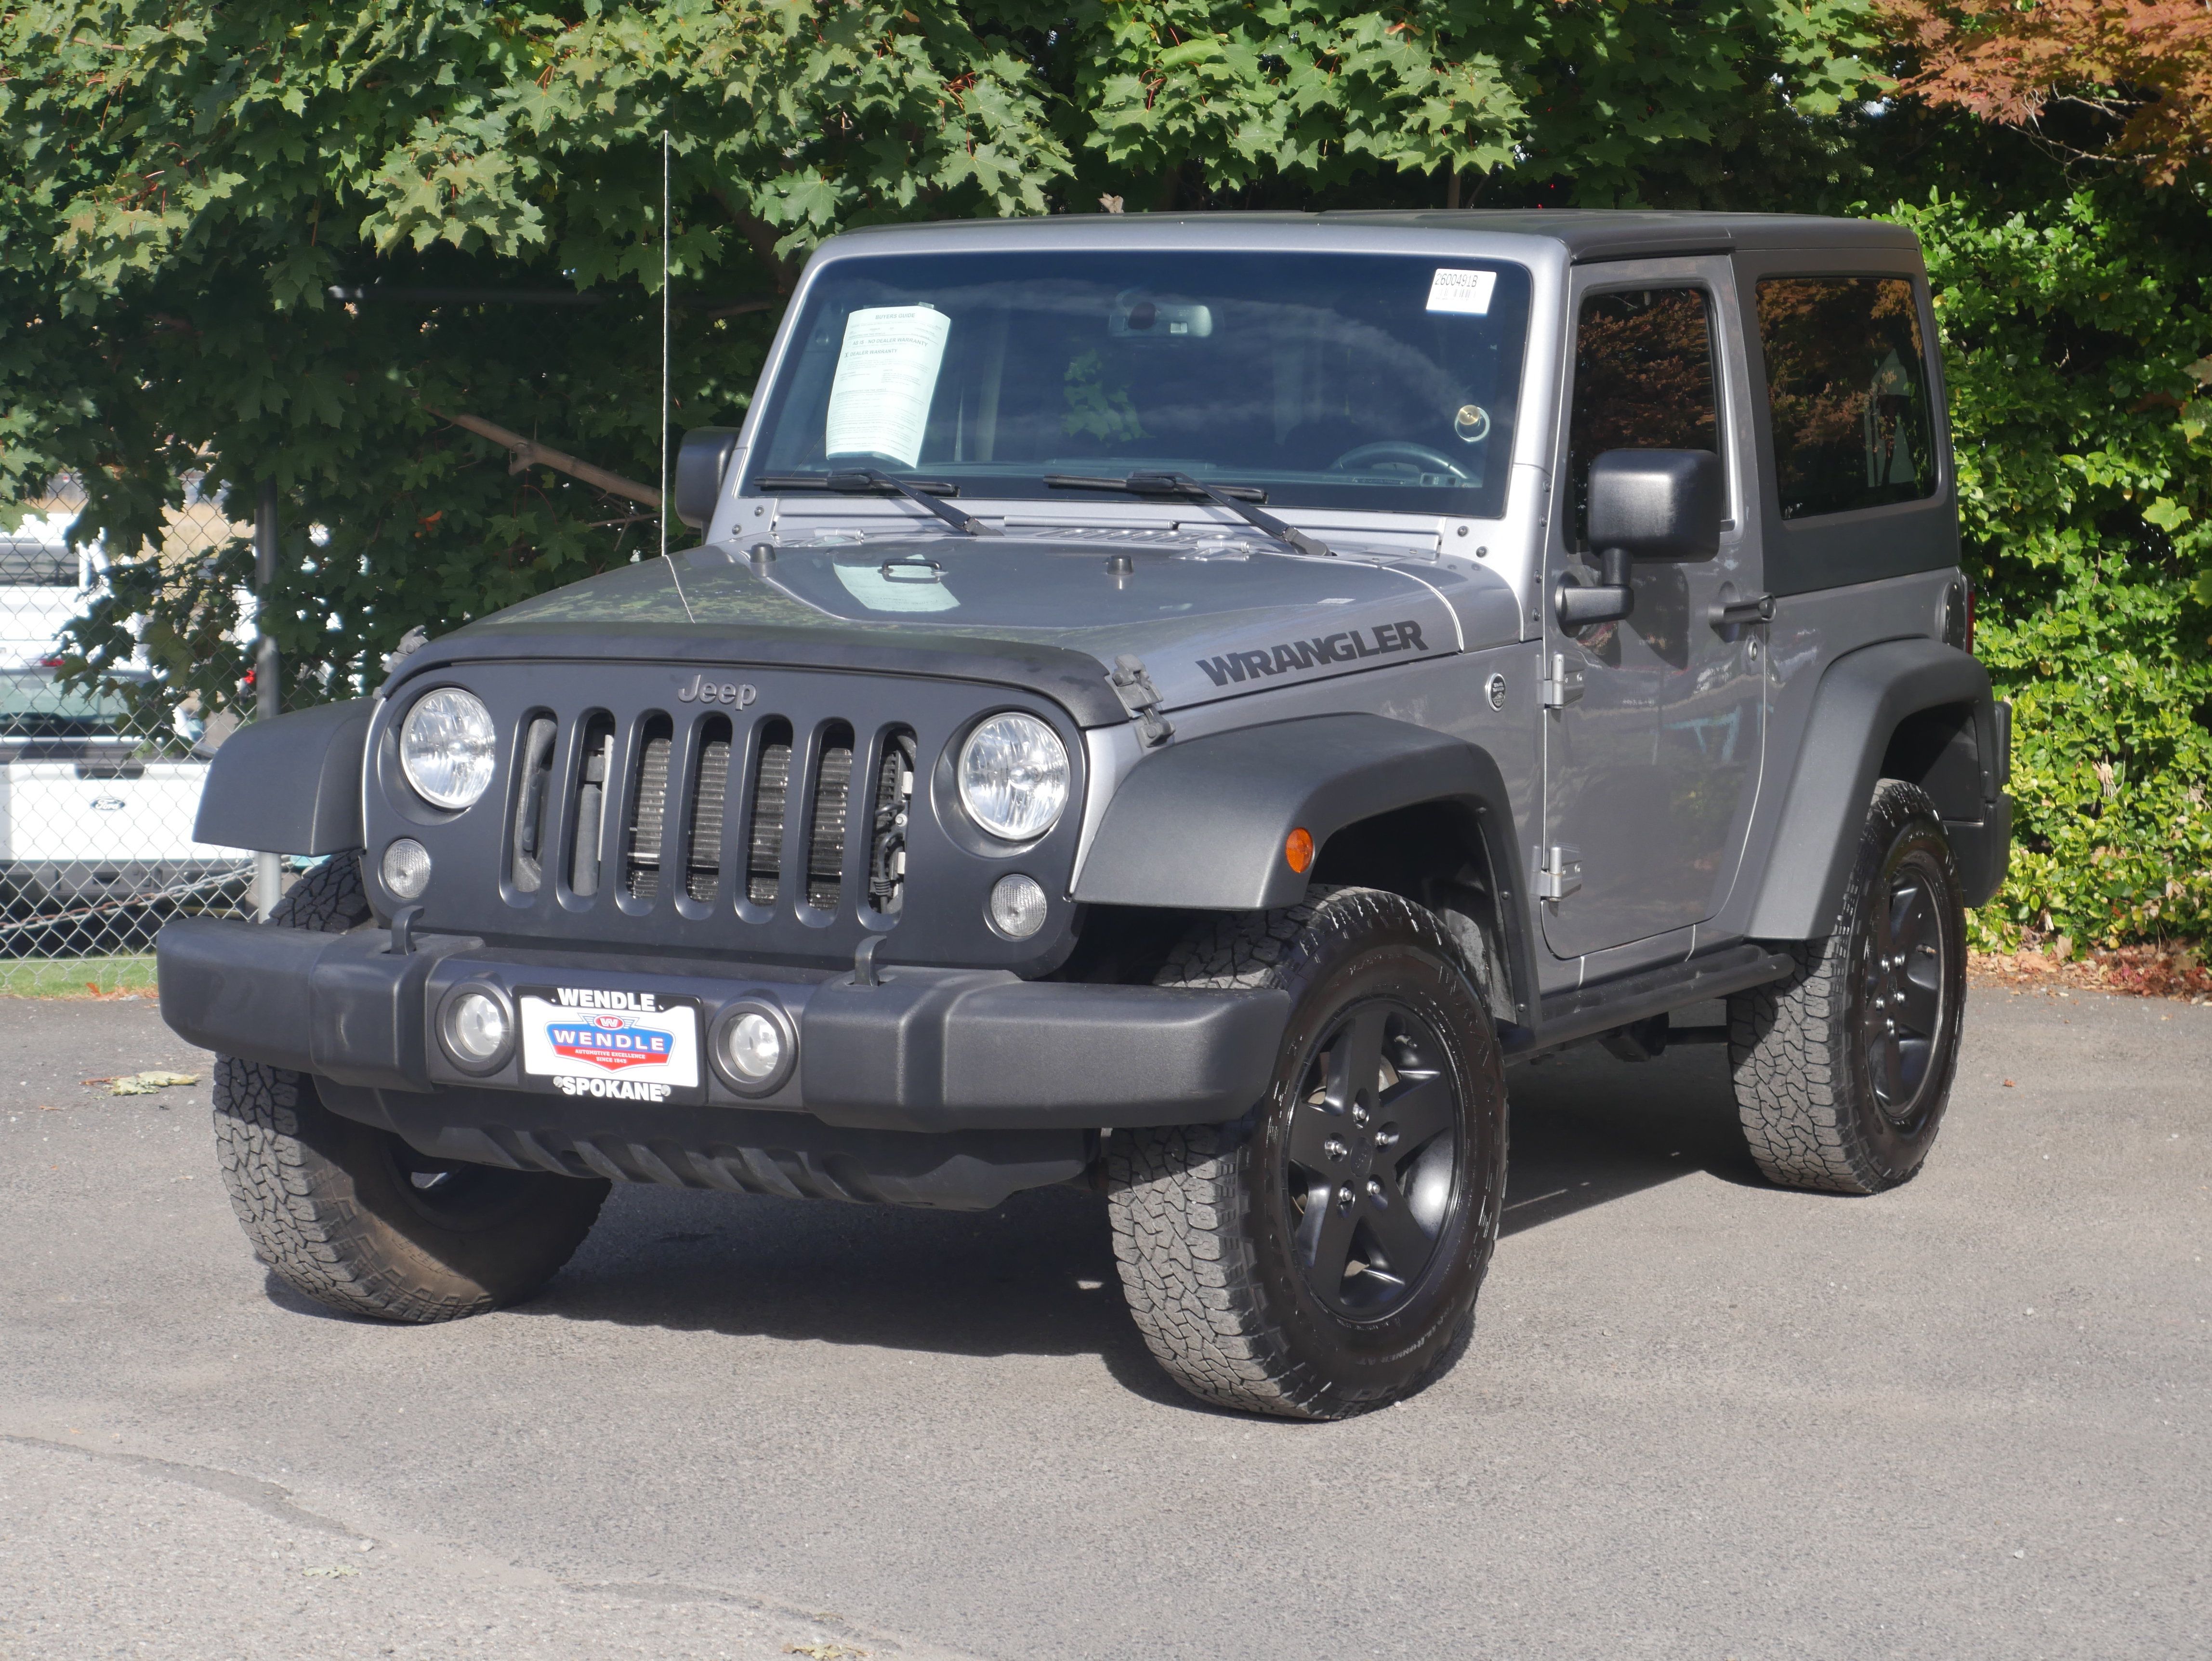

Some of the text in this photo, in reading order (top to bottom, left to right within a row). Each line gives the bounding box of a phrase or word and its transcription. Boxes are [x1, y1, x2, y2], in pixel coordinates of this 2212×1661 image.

[1435, 273, 1478, 287] 2600491B
[897, 338, 928, 347] WARRANTY
[1195, 620, 1429, 686] WRANGLER
[678, 674, 757, 711] Jeep
[95, 799, 119, 809] Ford
[557, 988, 656, 1012] WENDLE
[553, 1029, 664, 1051] WENDLE
[562, 1076, 663, 1102] SPOKANE
